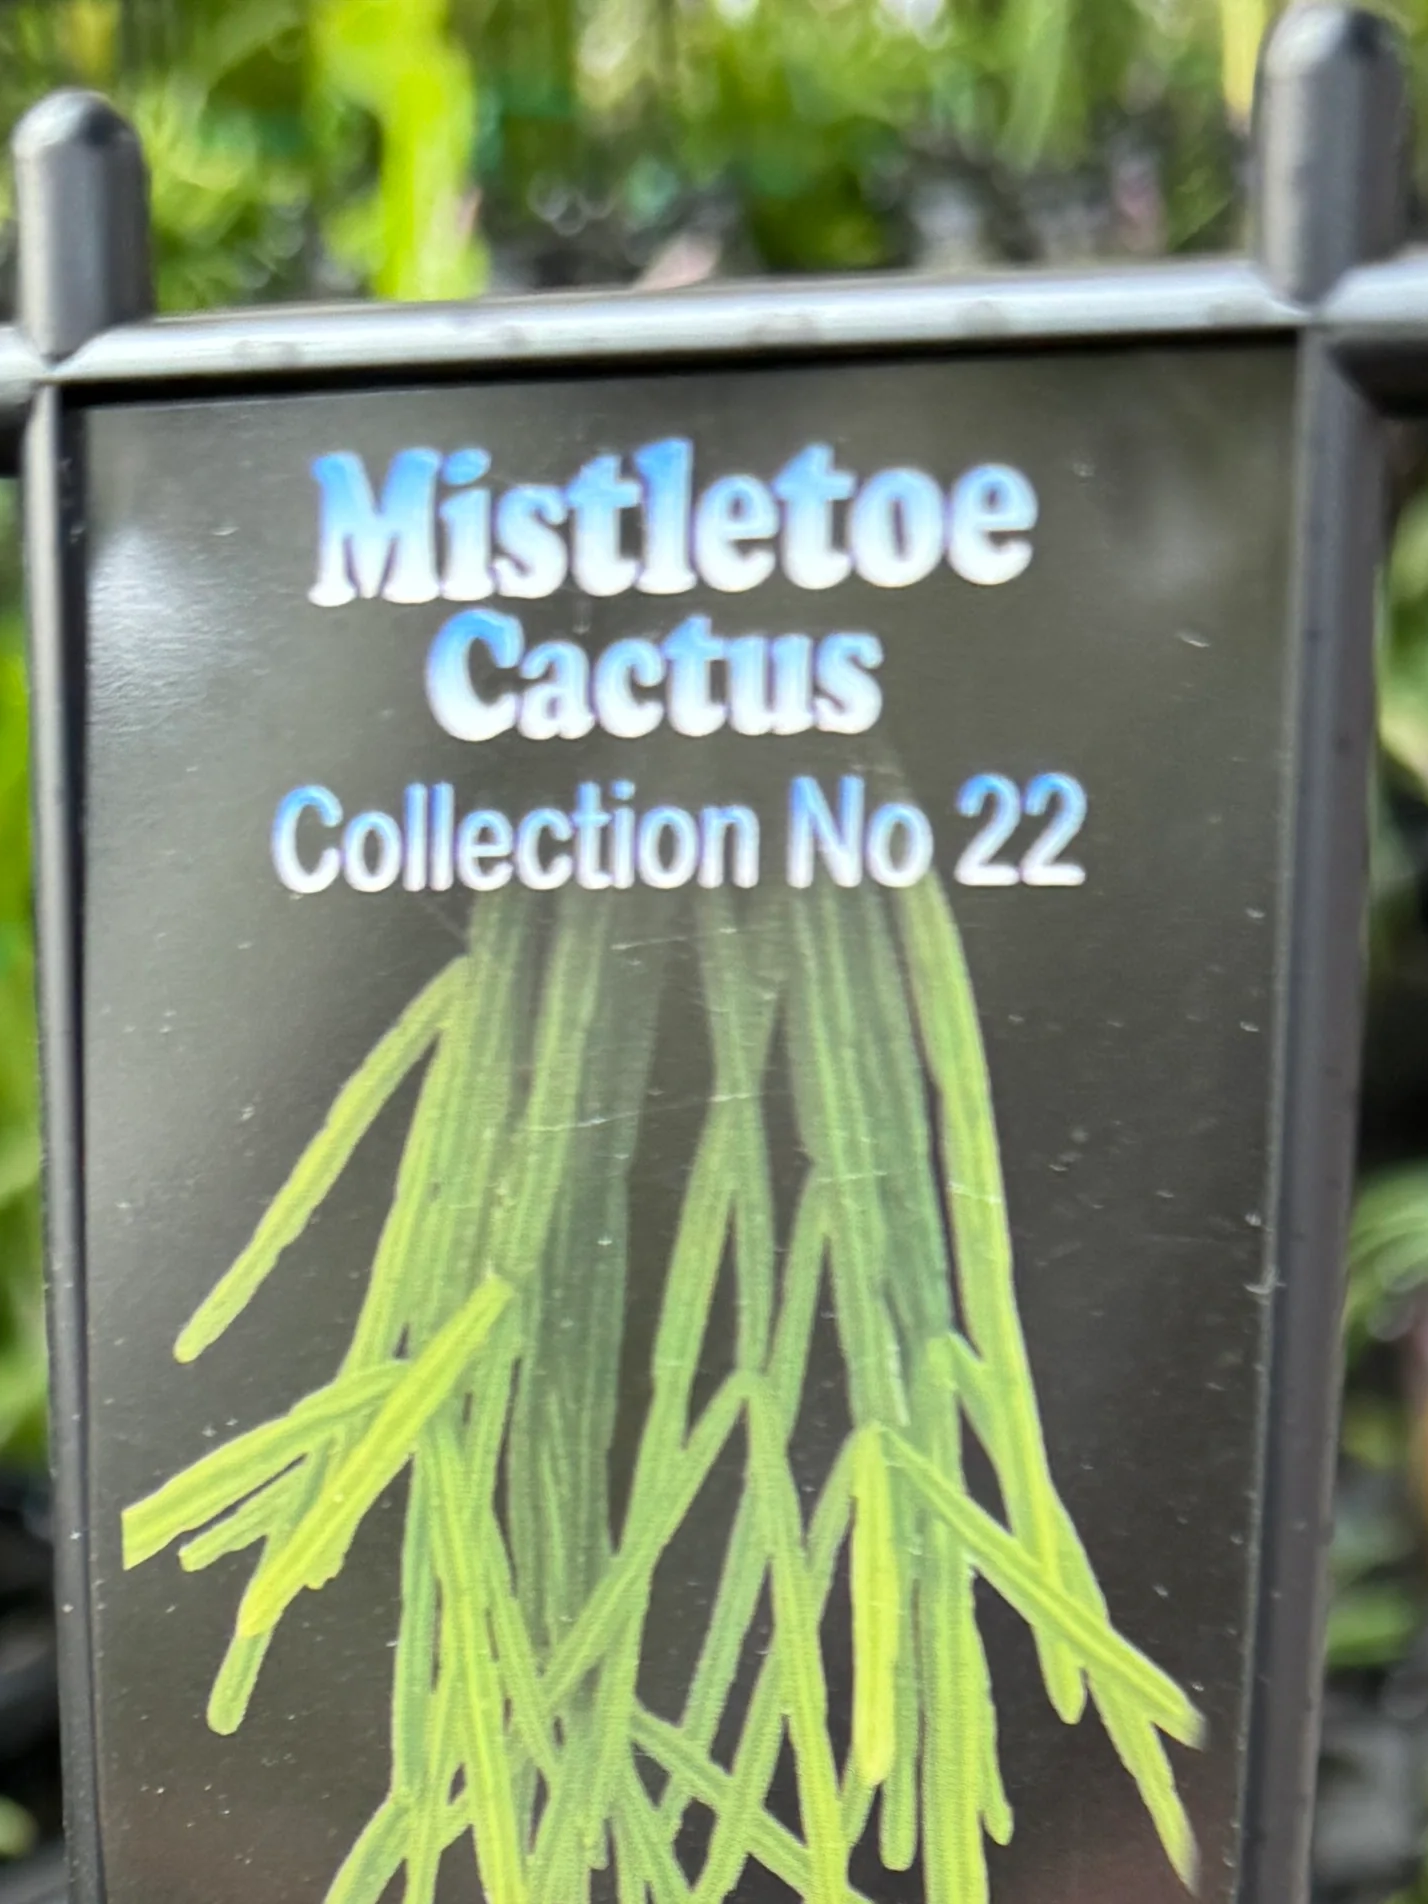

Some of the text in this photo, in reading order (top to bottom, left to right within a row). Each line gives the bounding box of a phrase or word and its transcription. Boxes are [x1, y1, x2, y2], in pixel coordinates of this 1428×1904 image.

[309, 439, 1038, 606] Mistletoe
[427, 608, 884, 742] Cactus
[272, 773, 1086, 893] Collection No 22
